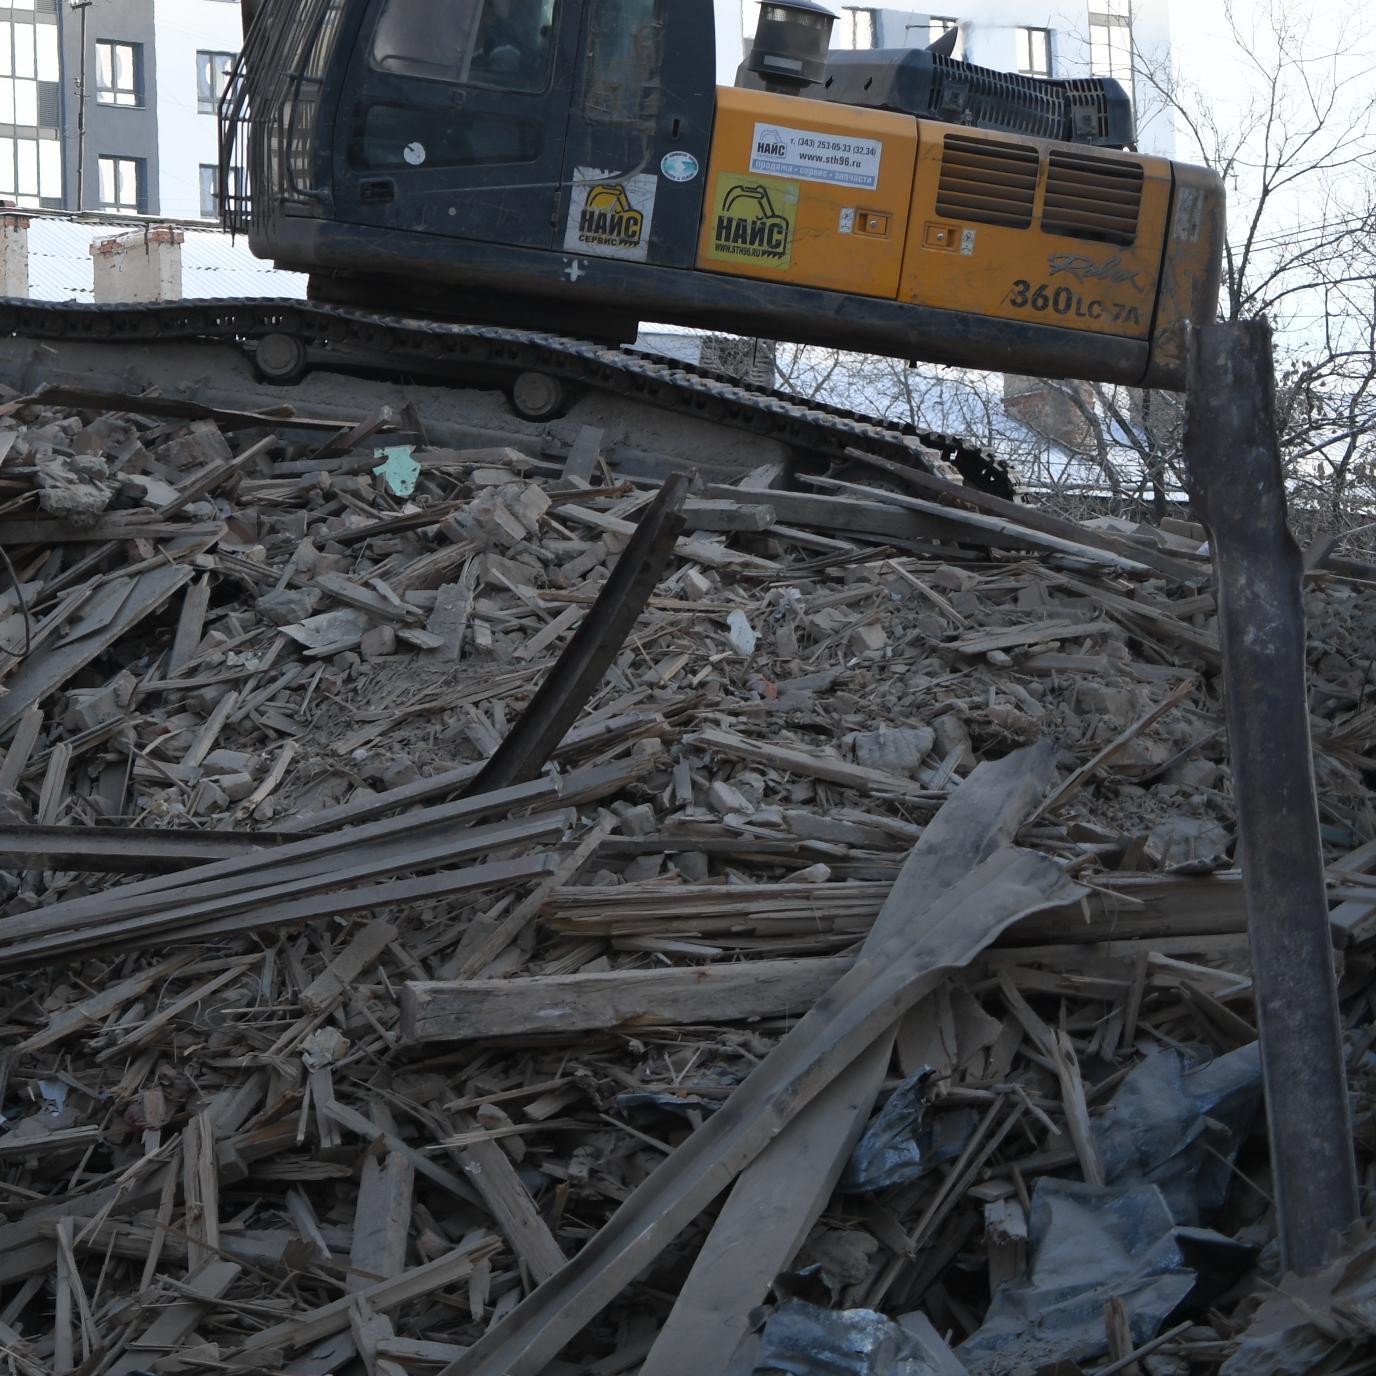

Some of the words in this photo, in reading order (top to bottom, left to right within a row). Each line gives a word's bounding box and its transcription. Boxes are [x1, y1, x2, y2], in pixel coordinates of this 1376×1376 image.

[757, 141, 785, 157] НАЙС
[797, 138, 815, 148] (343)
[799, 152, 862, 168] www.sth96.ru
[800, 169, 828, 179] сервис
[579, 209, 639, 239] НАЙС
[578, 234, 618, 246] СЕРВИС
[715, 215, 784, 250] НАЙС
